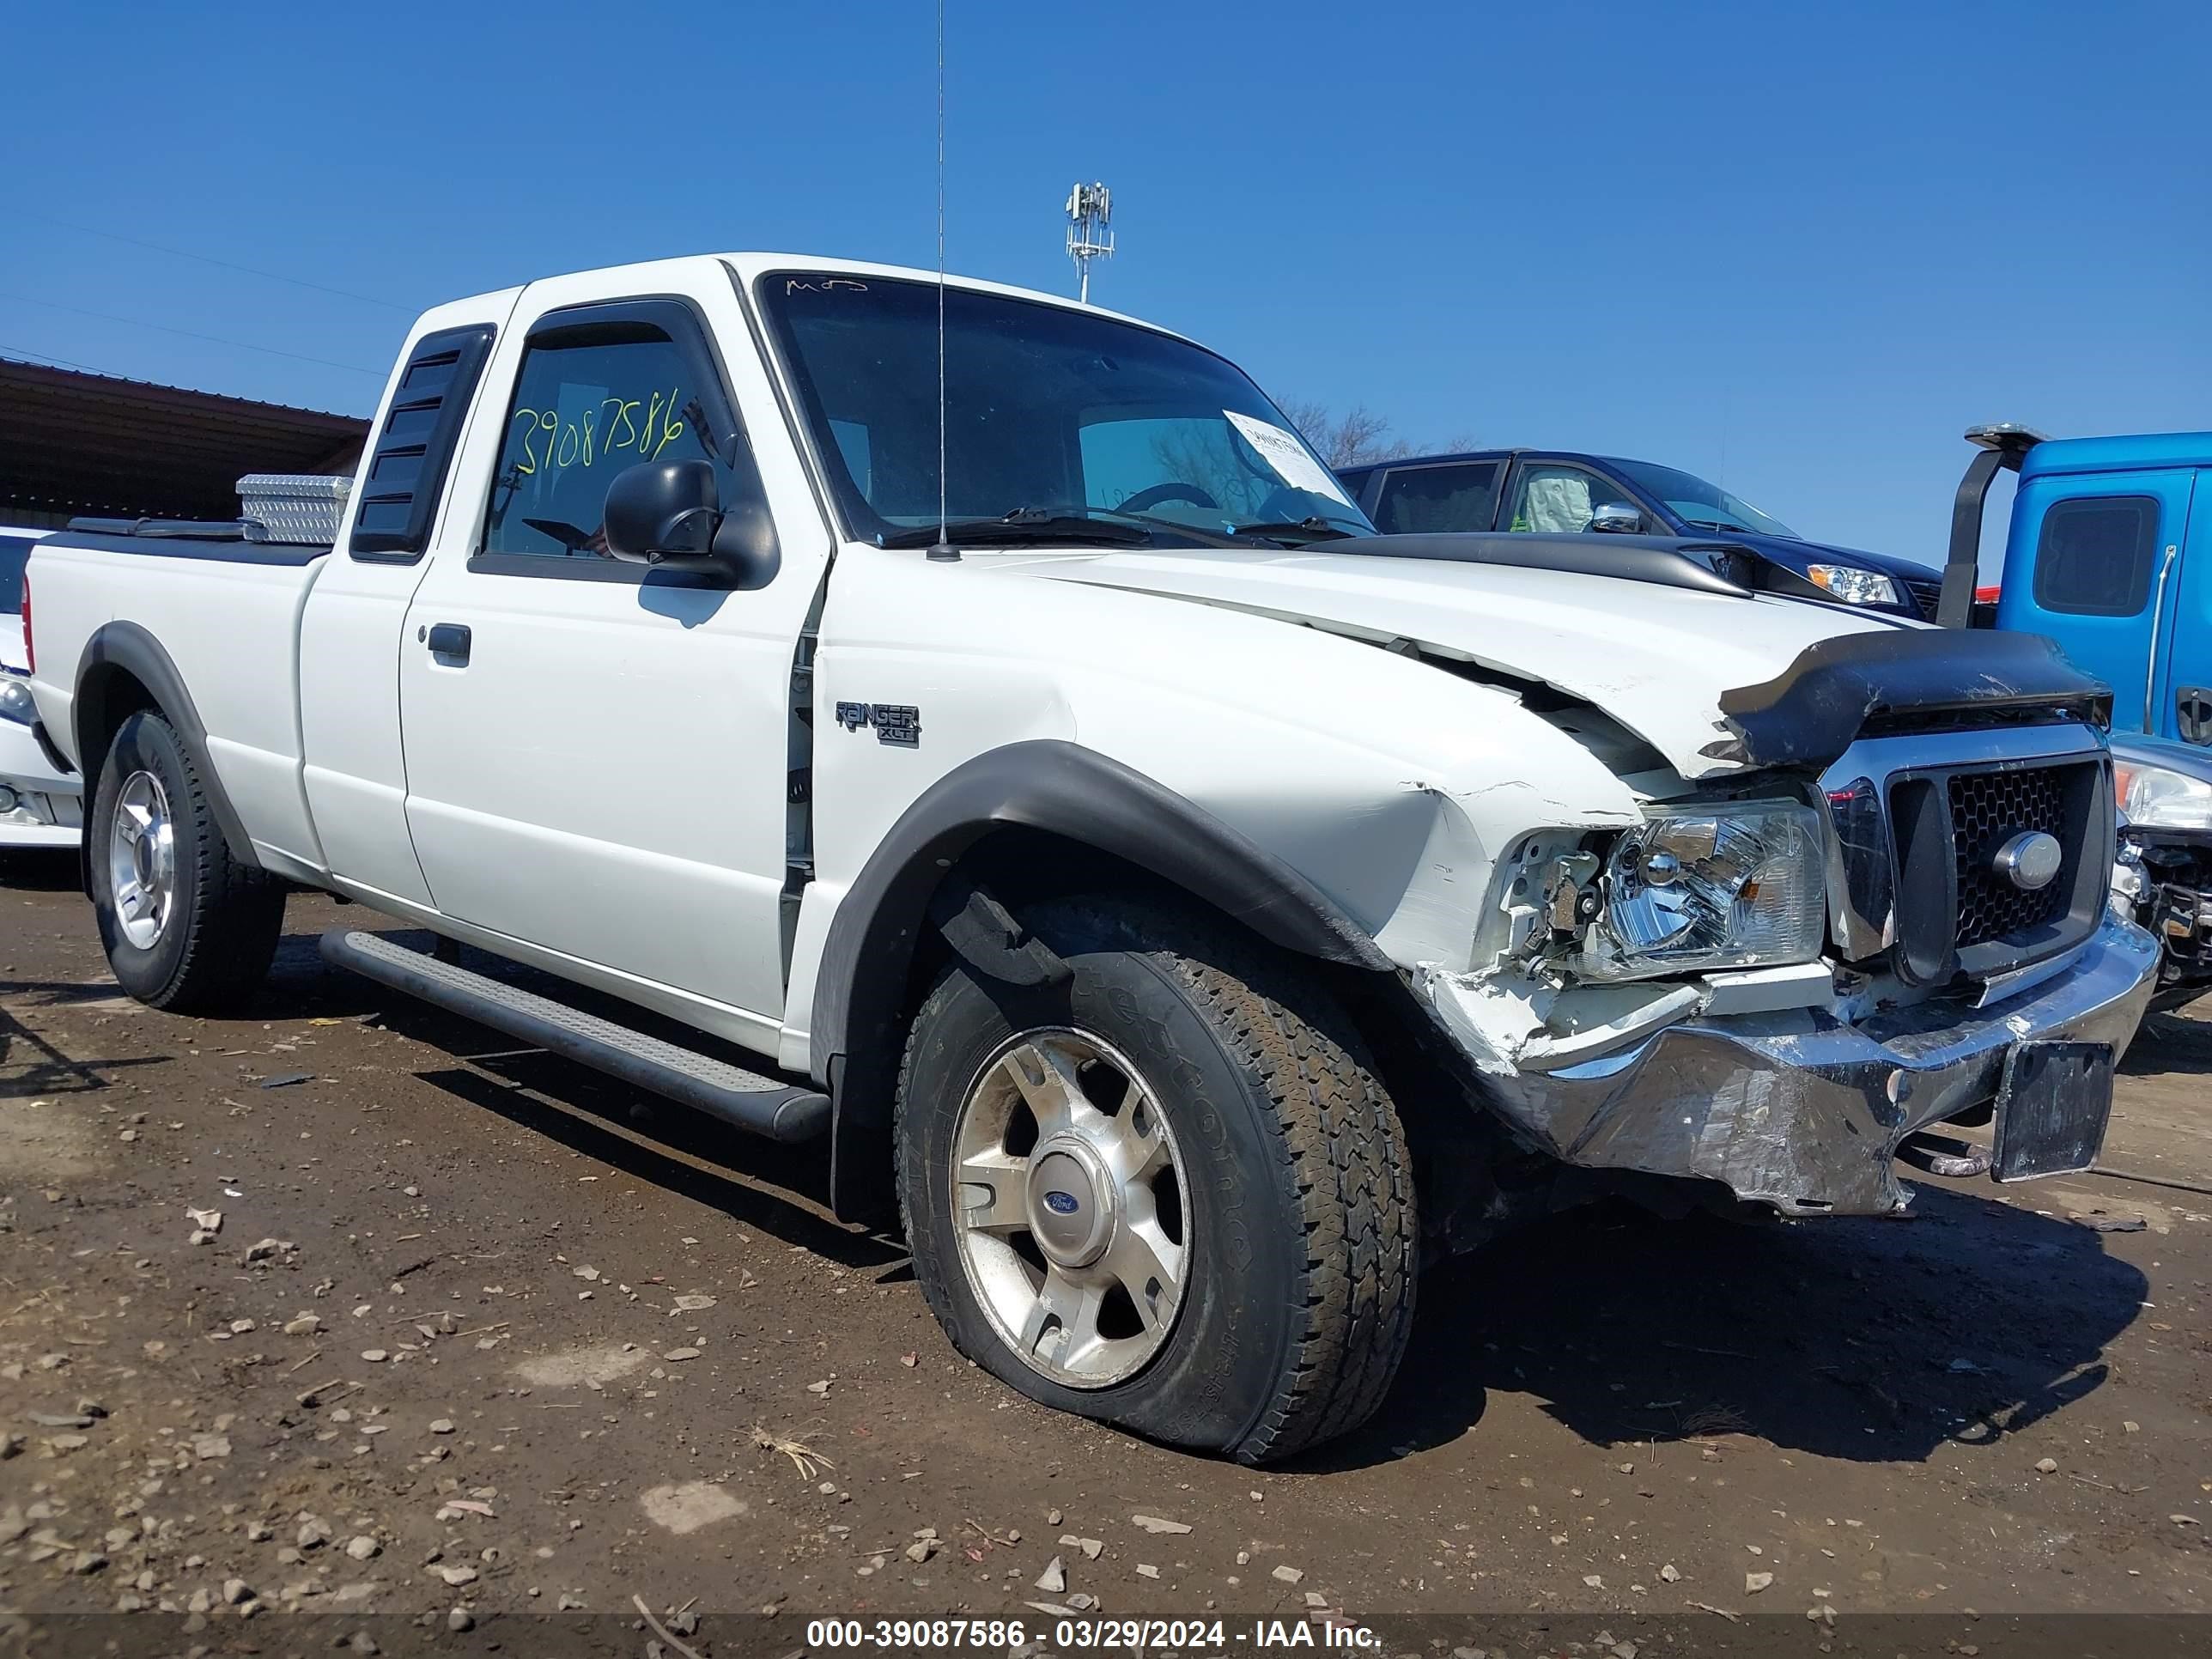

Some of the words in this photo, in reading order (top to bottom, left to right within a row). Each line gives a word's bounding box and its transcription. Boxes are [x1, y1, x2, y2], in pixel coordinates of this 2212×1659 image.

[514, 386, 684, 474] 39087586
[880, 728, 912, 740] XLT
[1052, 1195, 1073, 1211] Ford
